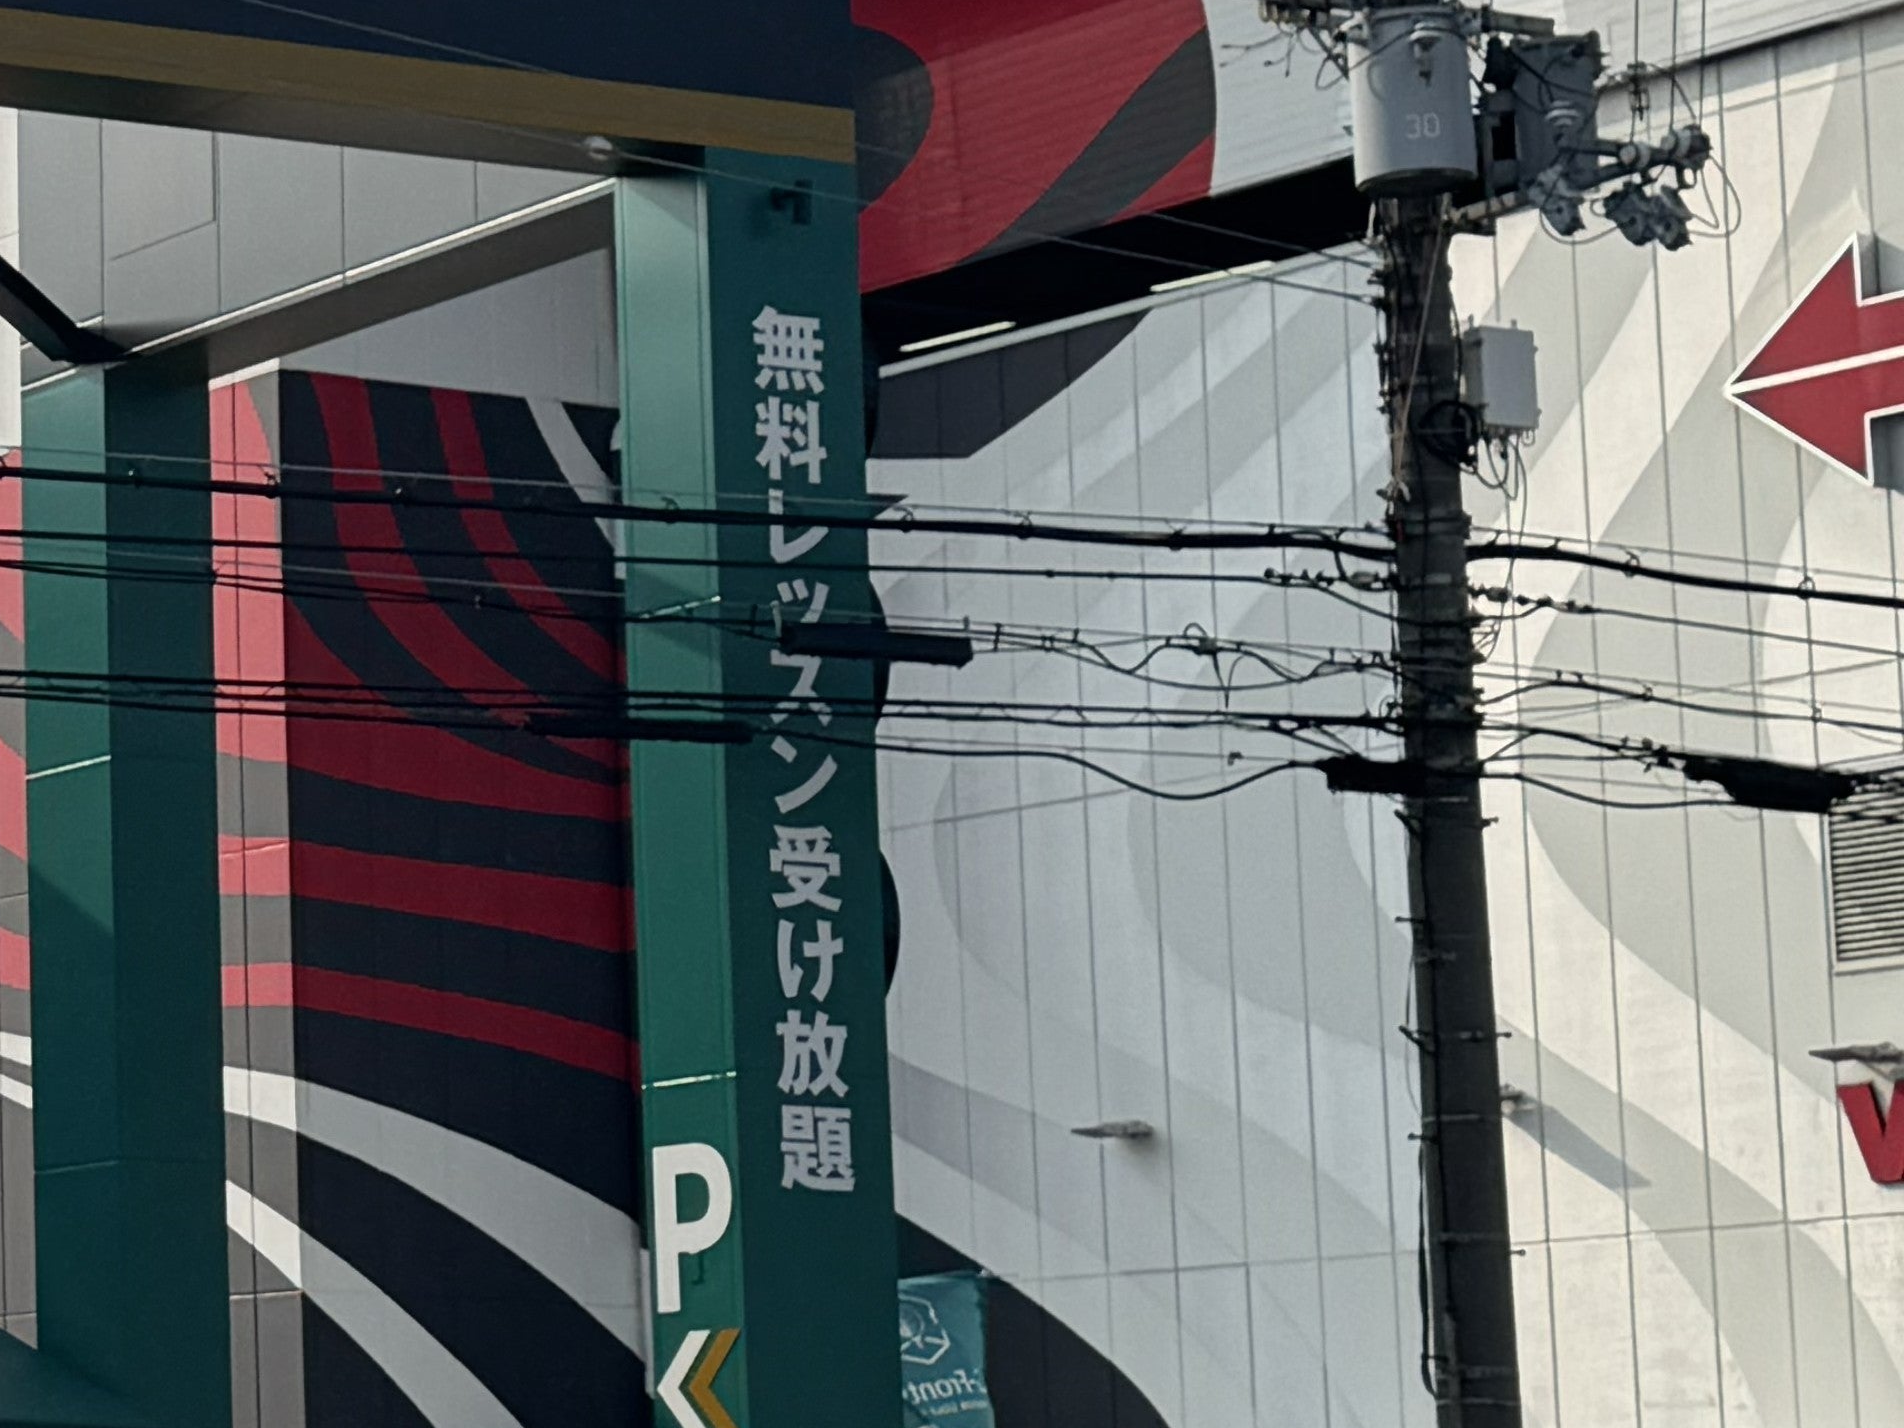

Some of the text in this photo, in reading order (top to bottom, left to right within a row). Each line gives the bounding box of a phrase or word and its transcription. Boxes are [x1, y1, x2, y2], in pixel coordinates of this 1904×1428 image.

[1405, 112, 1440, 140] 30
[753, 306, 855, 1192] 無料レッスン受け放題
[652, 1142, 732, 1312] P
